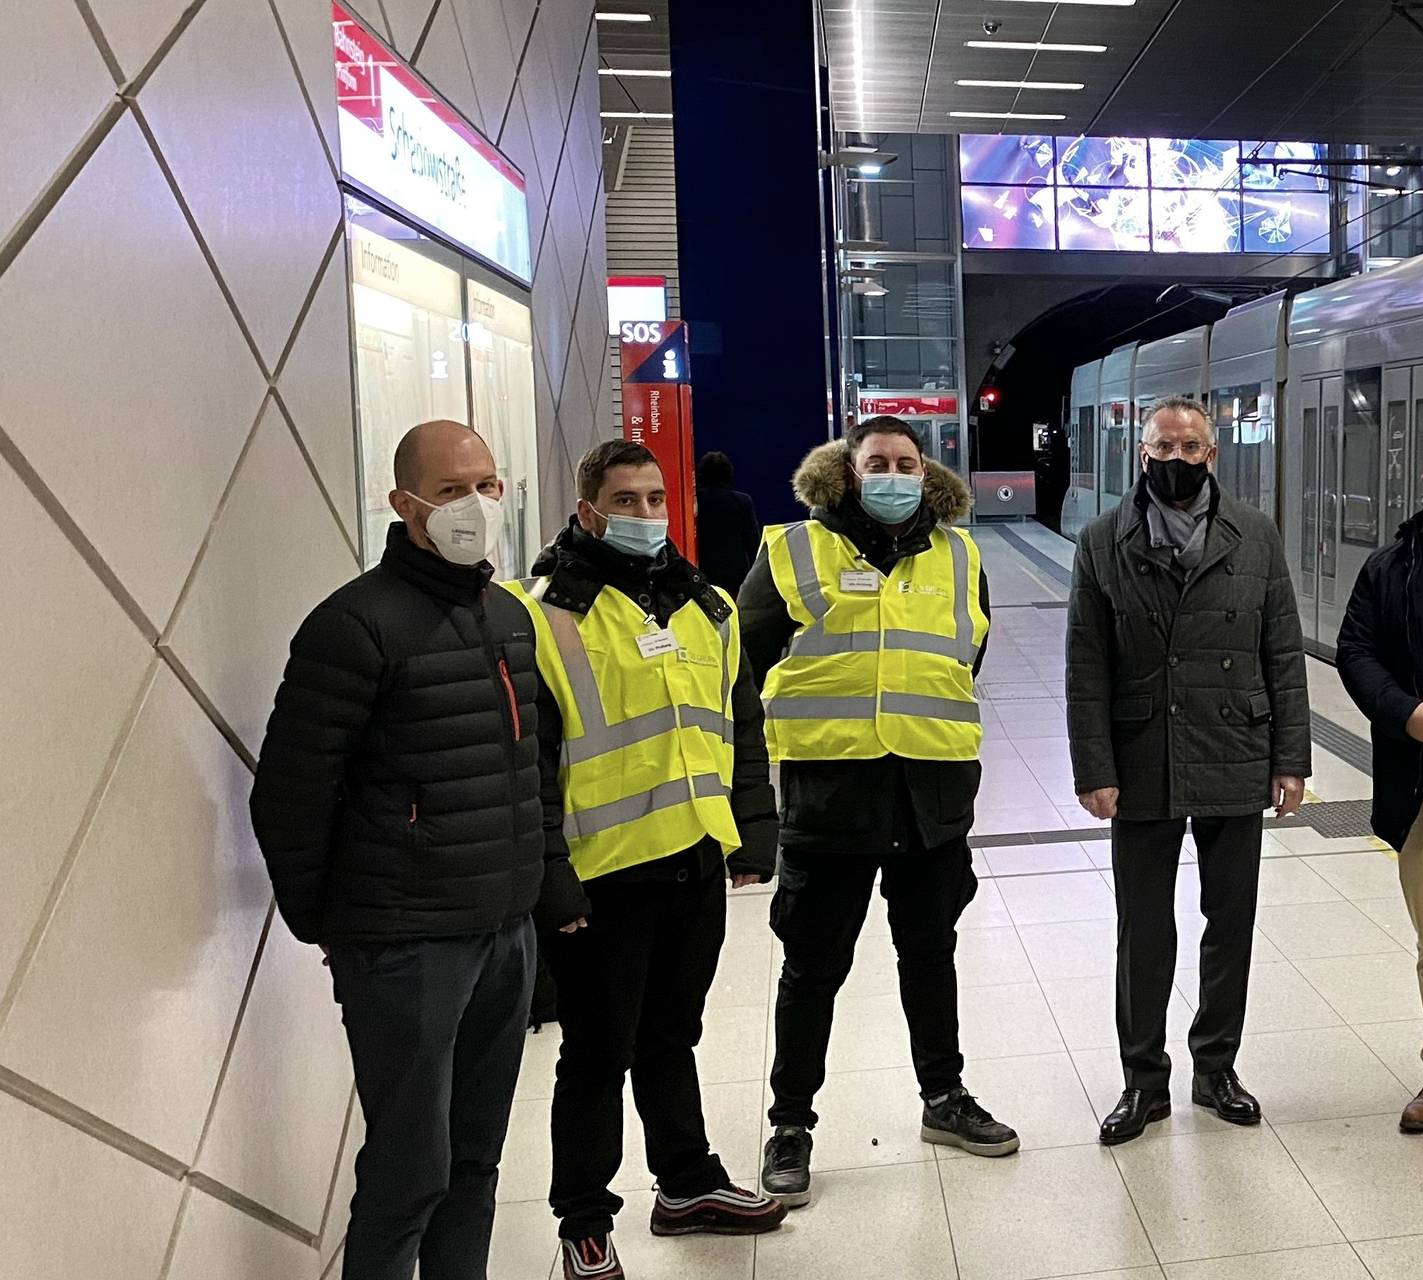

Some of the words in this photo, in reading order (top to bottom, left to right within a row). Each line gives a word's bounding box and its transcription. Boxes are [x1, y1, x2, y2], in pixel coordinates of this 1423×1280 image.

[621, 322, 662, 344] SOS
[650, 390, 661, 434] Rheinbahn
[631, 428, 645, 446] Inf
